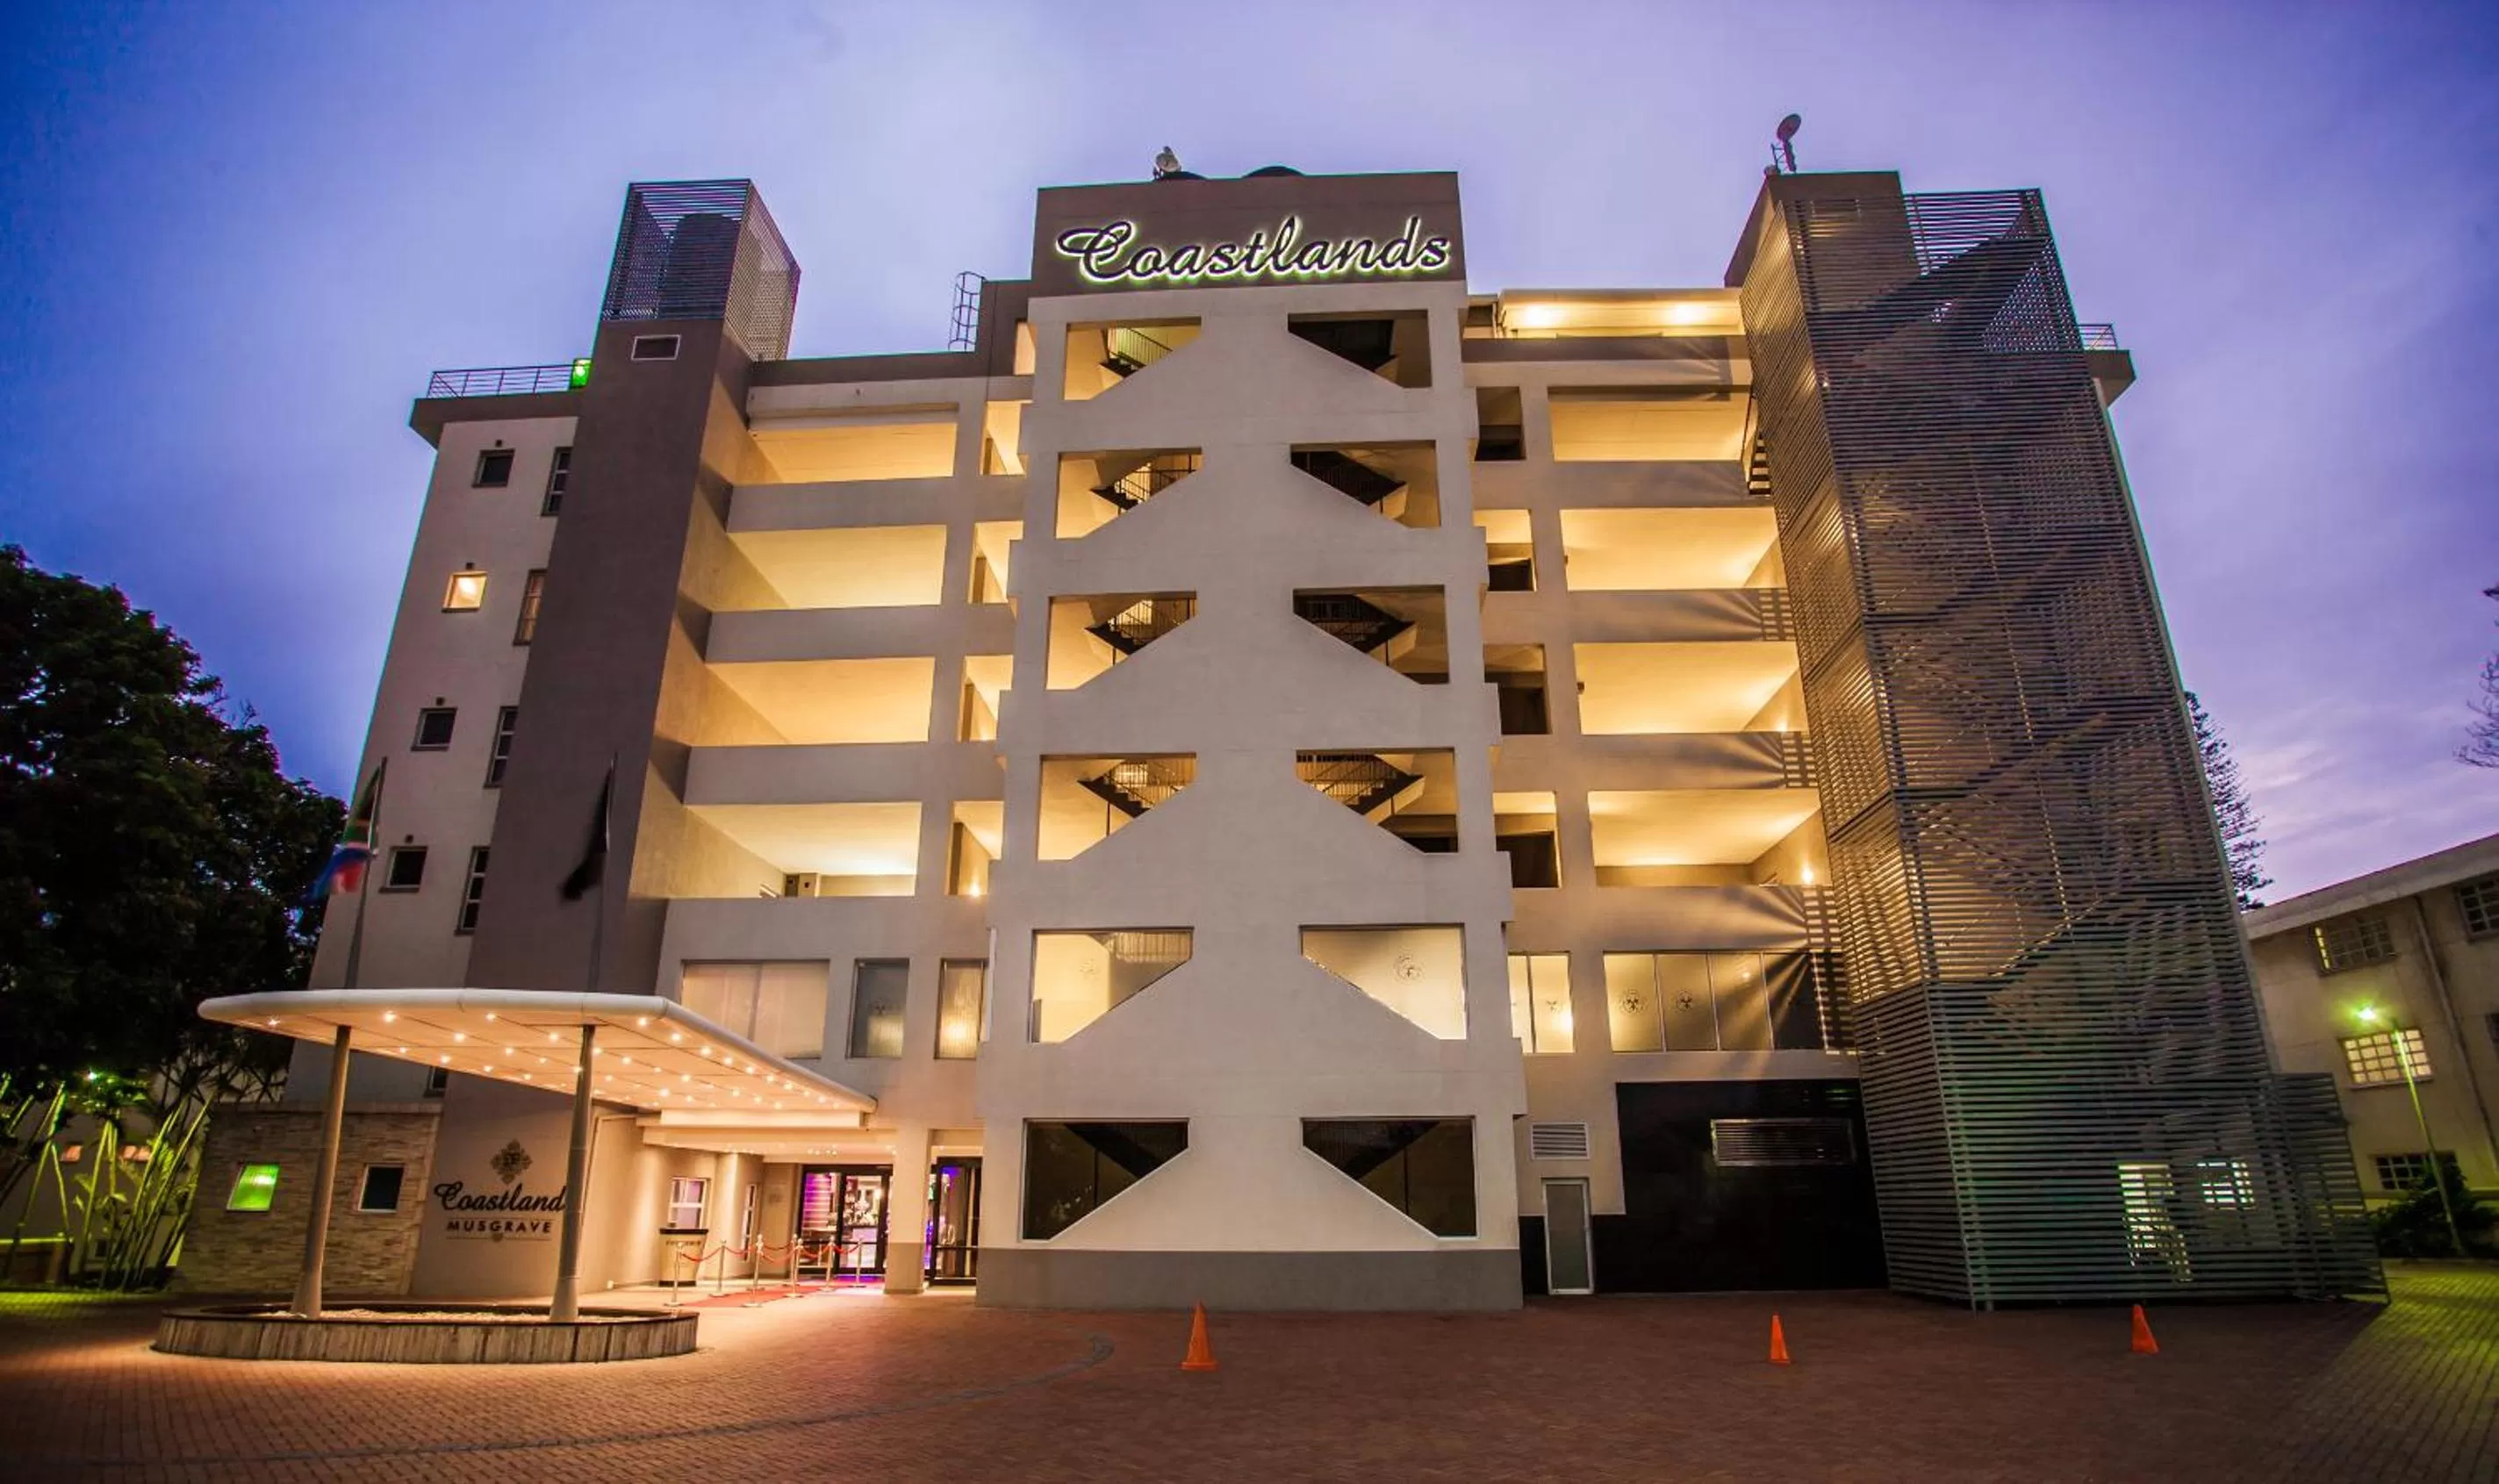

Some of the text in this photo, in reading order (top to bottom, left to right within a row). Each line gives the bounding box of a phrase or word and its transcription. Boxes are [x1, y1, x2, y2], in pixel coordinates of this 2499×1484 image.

[1056, 216, 1450, 279] Coastlands
[434, 1181, 567, 1212] Coastland
[447, 1220, 551, 1233] MUSGRAVE
